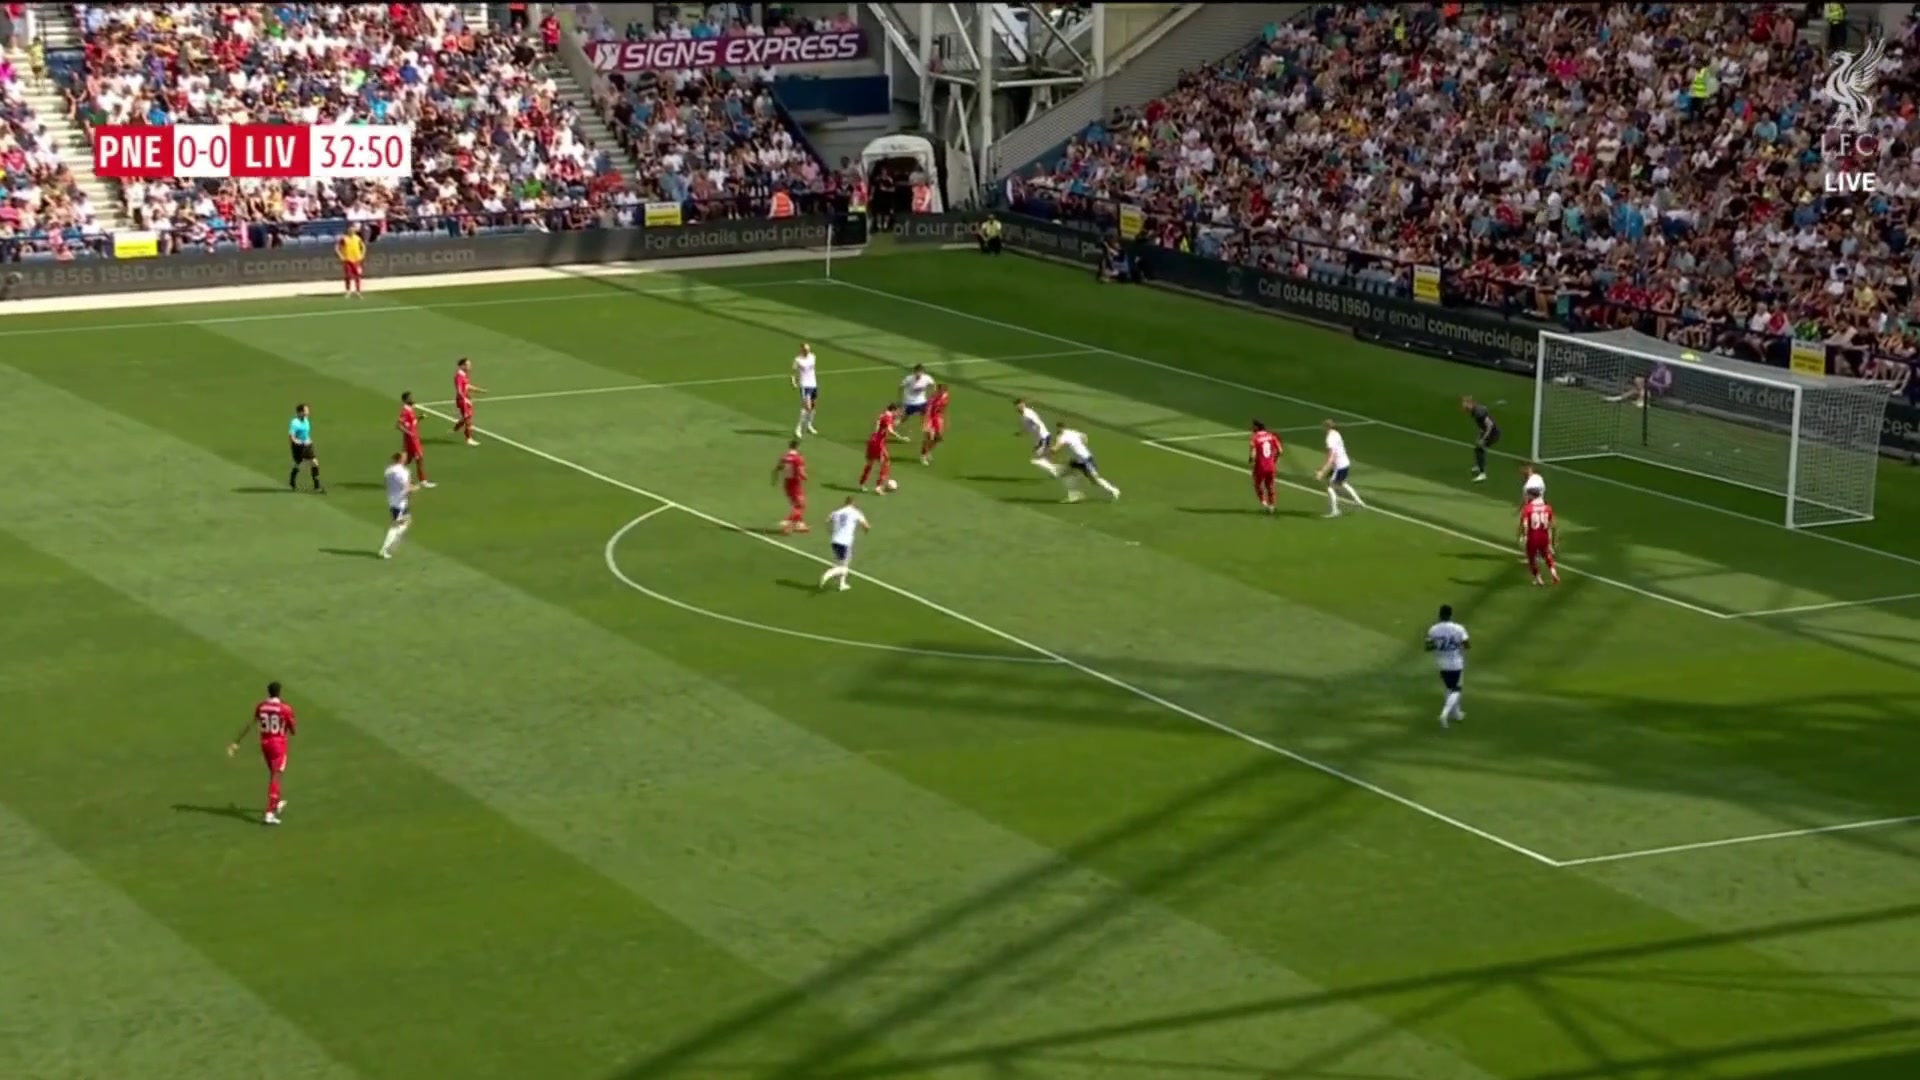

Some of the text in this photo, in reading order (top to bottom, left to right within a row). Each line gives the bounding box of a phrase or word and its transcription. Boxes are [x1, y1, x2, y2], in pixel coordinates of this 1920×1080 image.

[624, 33, 859, 68] SIGNS EXPRESS
[644, 234, 671, 250] For
[677, 229, 737, 249] details
[742, 226, 778, 244] and
[894, 219, 910, 236] of
[916, 220, 948, 237] our
[52, 266, 94, 286] 856
[100, 264, 148, 284] 1960
[153, 266, 174, 281] or
[1258, 277, 1280, 300] Call
[1283, 283, 1314, 307] 0344
[1315, 291, 1339, 313] 856
[1341, 296, 1371, 318] 1960
[1372, 307, 1387, 323] or
[1389, 310, 1425, 332] email
[1728, 381, 1752, 405] For
[260, 712, 280, 734] 38
